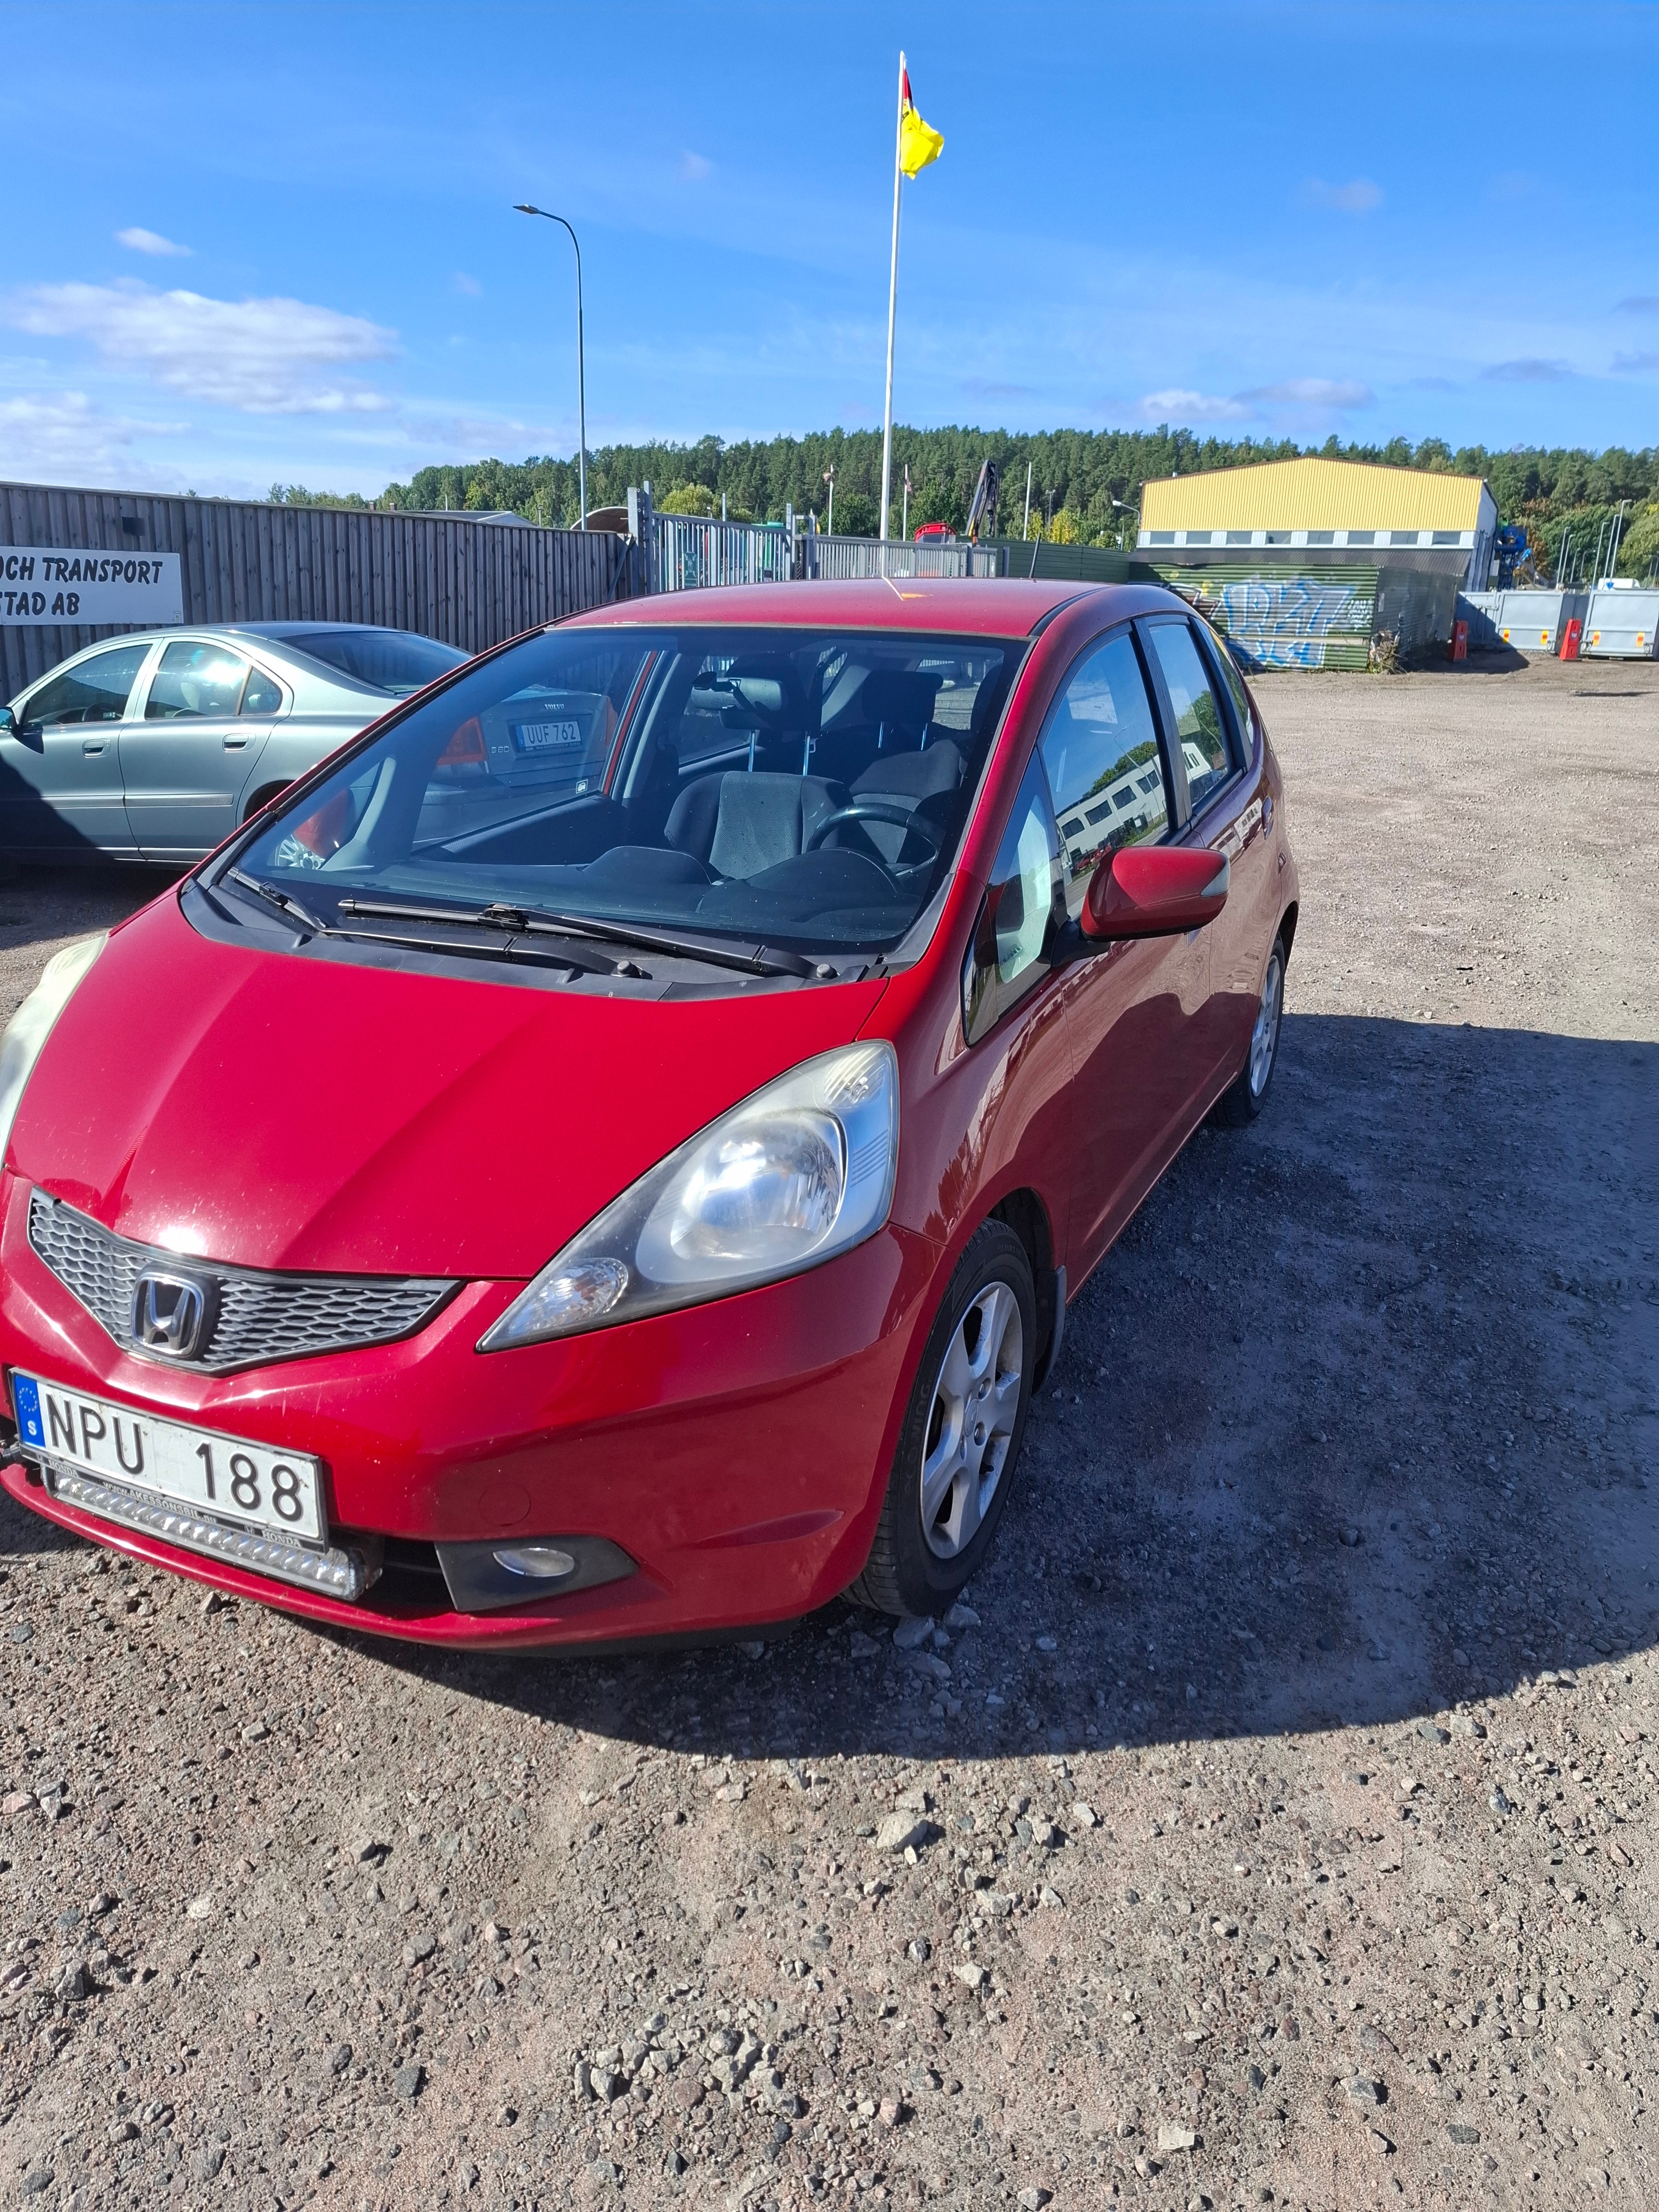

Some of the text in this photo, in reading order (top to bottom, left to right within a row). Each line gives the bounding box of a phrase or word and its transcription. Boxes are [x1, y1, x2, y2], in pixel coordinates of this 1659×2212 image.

[0, 555, 163, 585] CH TRANSPORT
[0, 591, 80, 616] TAD AB
[527, 725, 549, 744] UUF
[552, 723, 576, 741] 762
[27, 1391, 304, 1522] S NPU 188
[48, 1459, 79, 1477] HONDA
[261, 1530, 301, 1547] HONDA
